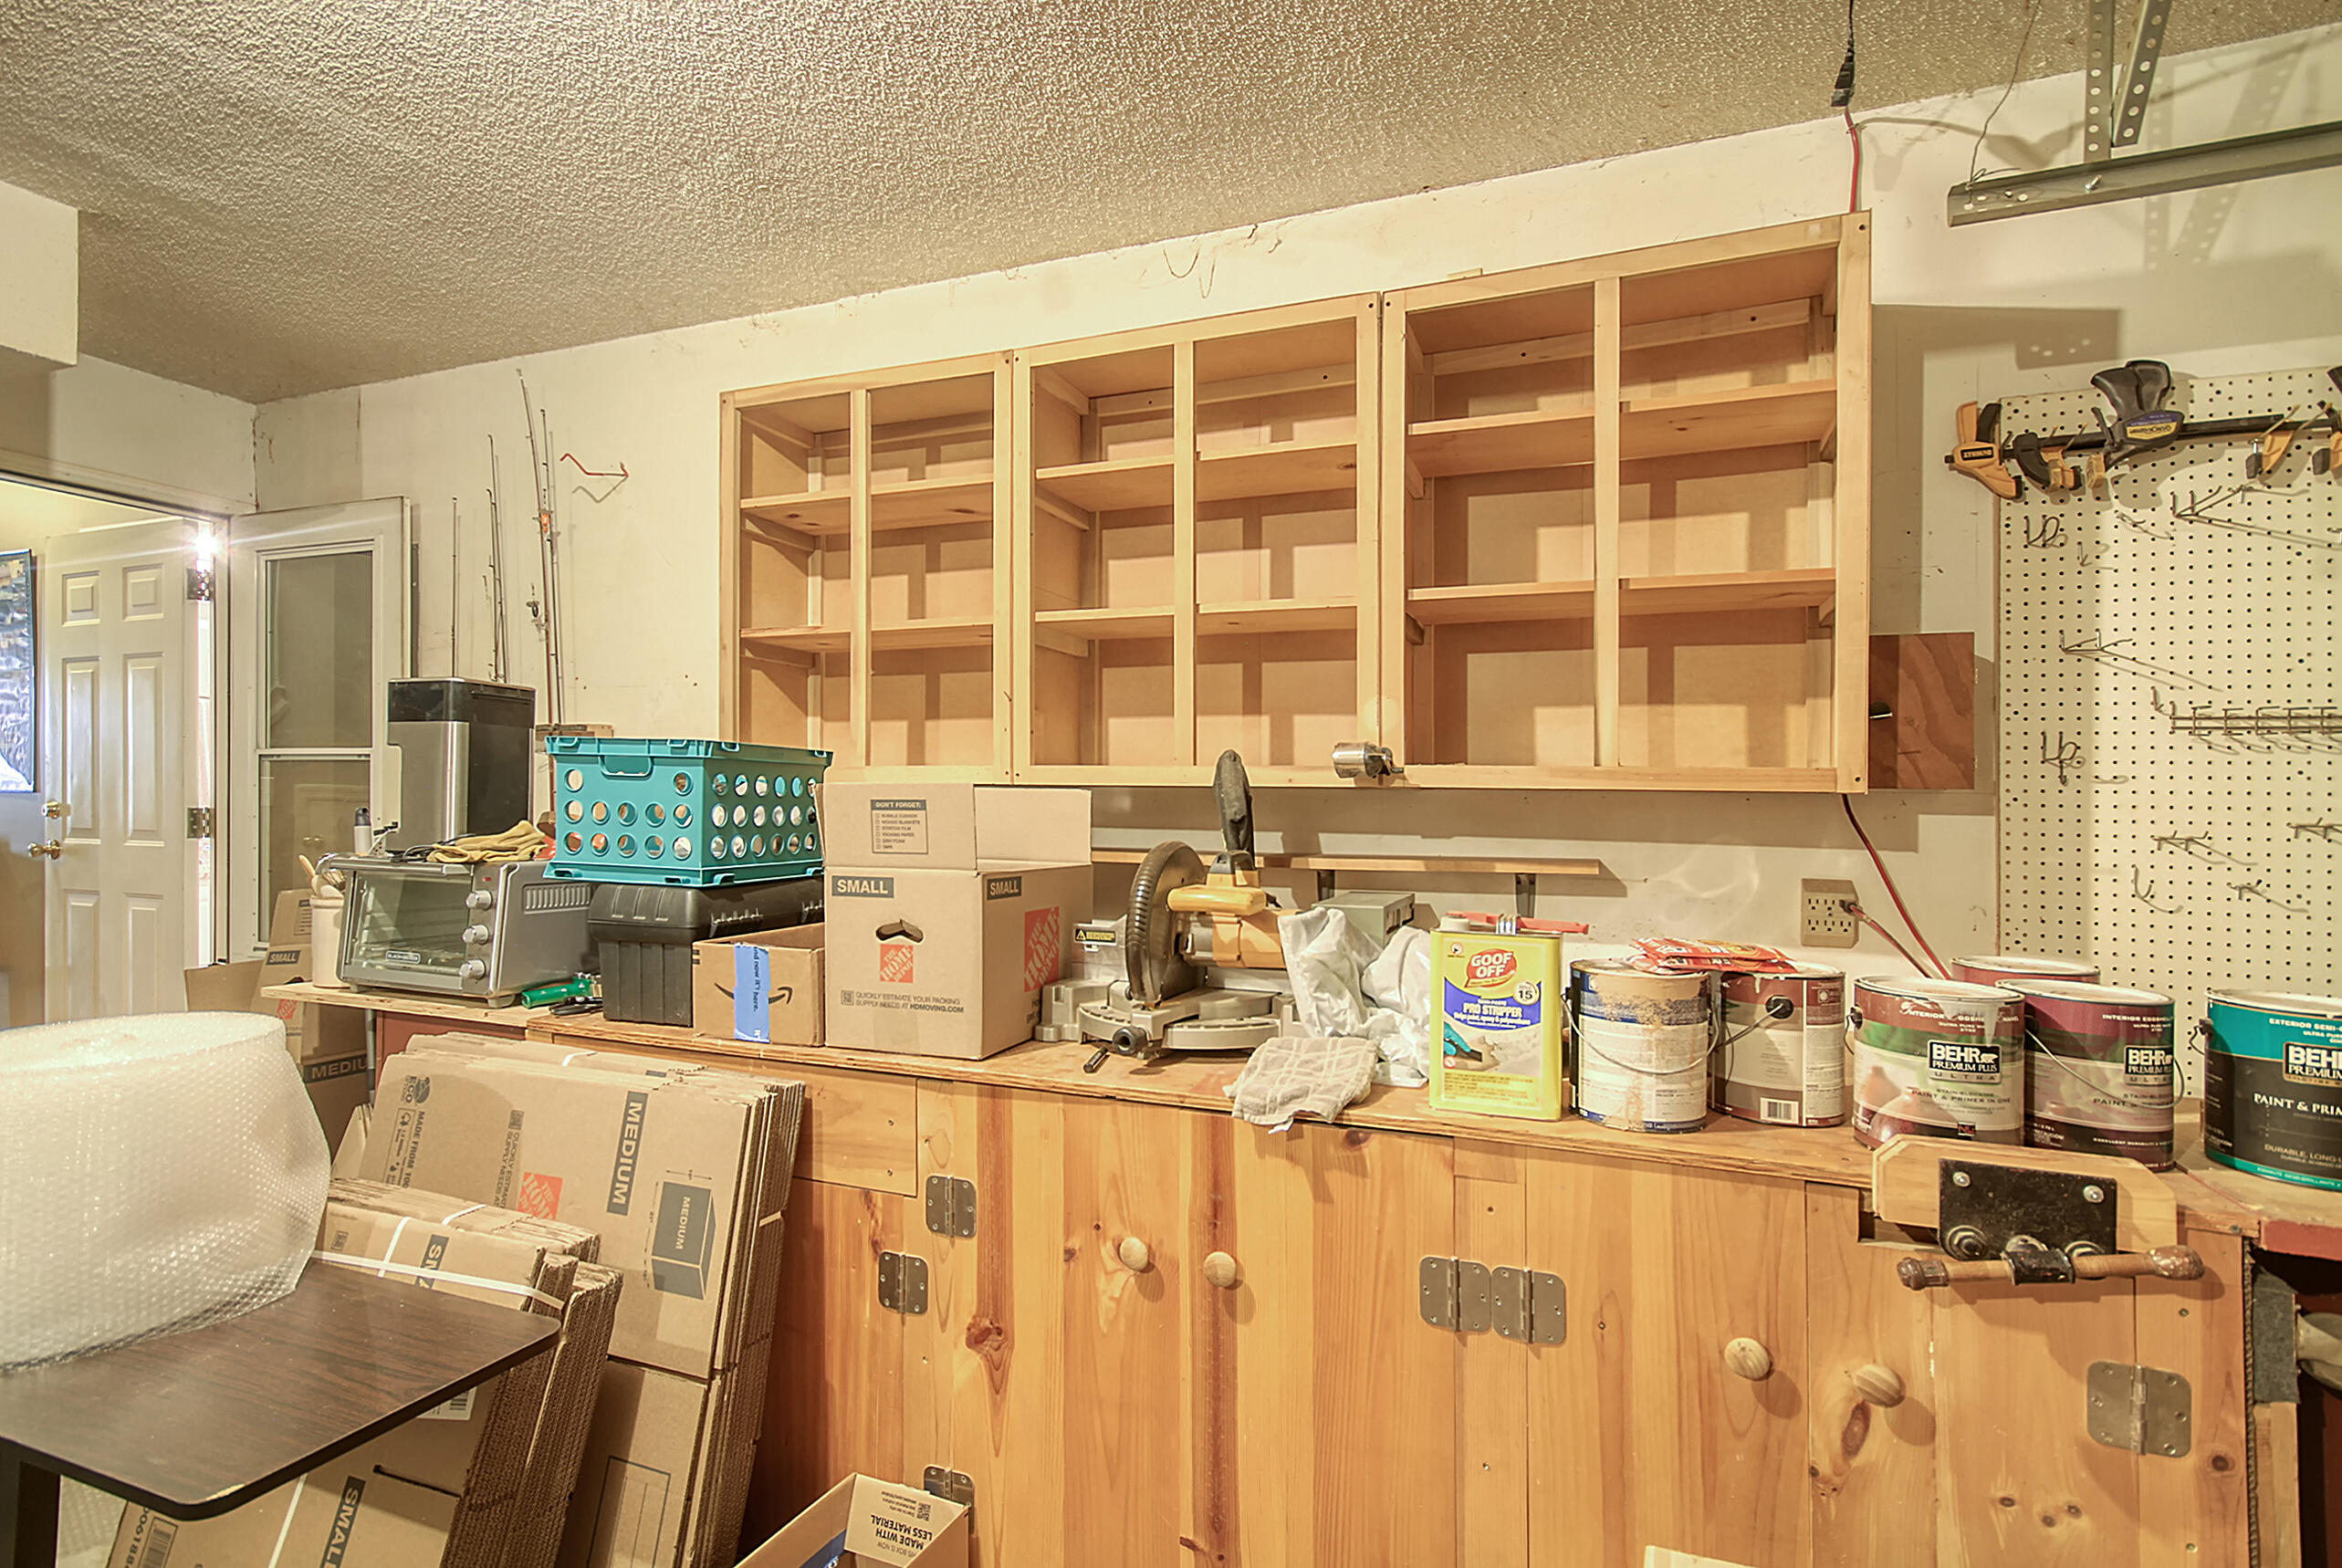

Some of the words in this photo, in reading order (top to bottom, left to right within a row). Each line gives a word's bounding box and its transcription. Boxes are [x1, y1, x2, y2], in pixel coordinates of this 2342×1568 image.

[837, 879, 888, 894] SMALL
[989, 879, 1019, 895] SMALL
[270, 952, 297, 963] SMALL
[881, 946, 913, 981] HOME
[1470, 952, 1512, 967] GOOF
[1476, 965, 1505, 977] OFF
[855, 991, 881, 999] QUICKLY
[883, 993, 911, 1001] ESTIMATE
[1518, 990, 1532, 999] 15
[1481, 1005, 1522, 1018] STRIPPER
[2269, 1018, 2312, 1029] EXTERIOR
[1932, 1044, 1981, 1063] BEHR
[2128, 1049, 2165, 1065] BEHR
[311, 1058, 367, 1079] MEDIU
[1932, 1060, 1975, 1071] PREMIUM
[1978, 1063, 1997, 1072] PLUS
[1935, 1071, 1996, 1081] ULTRA
[405, 1075, 417, 1103] ECO
[1911, 1090, 1938, 1098] PAINT
[1951, 1095, 1984, 1103] PRIMER
[2093, 1098, 2127, 1106] PAINT
[2253, 1092, 2295, 1109] PAINT
[2296, 1102, 2308, 1112] &
[413, 1111, 425, 1139] MADE
[407, 1141, 419, 1169] FROM
[507, 1132, 519, 1169] QUICKLY
[613, 1101, 643, 1205] MEDIUM
[2264, 1144, 2307, 1156] DURABLE,
[675, 1197, 690, 1249] MEDIUM
[871, 1514, 911, 1535] MATERIAL
[875, 1528, 898, 1542] WITH
[913, 1529, 933, 1541] LESS
[900, 1536, 924, 1550] MADE
